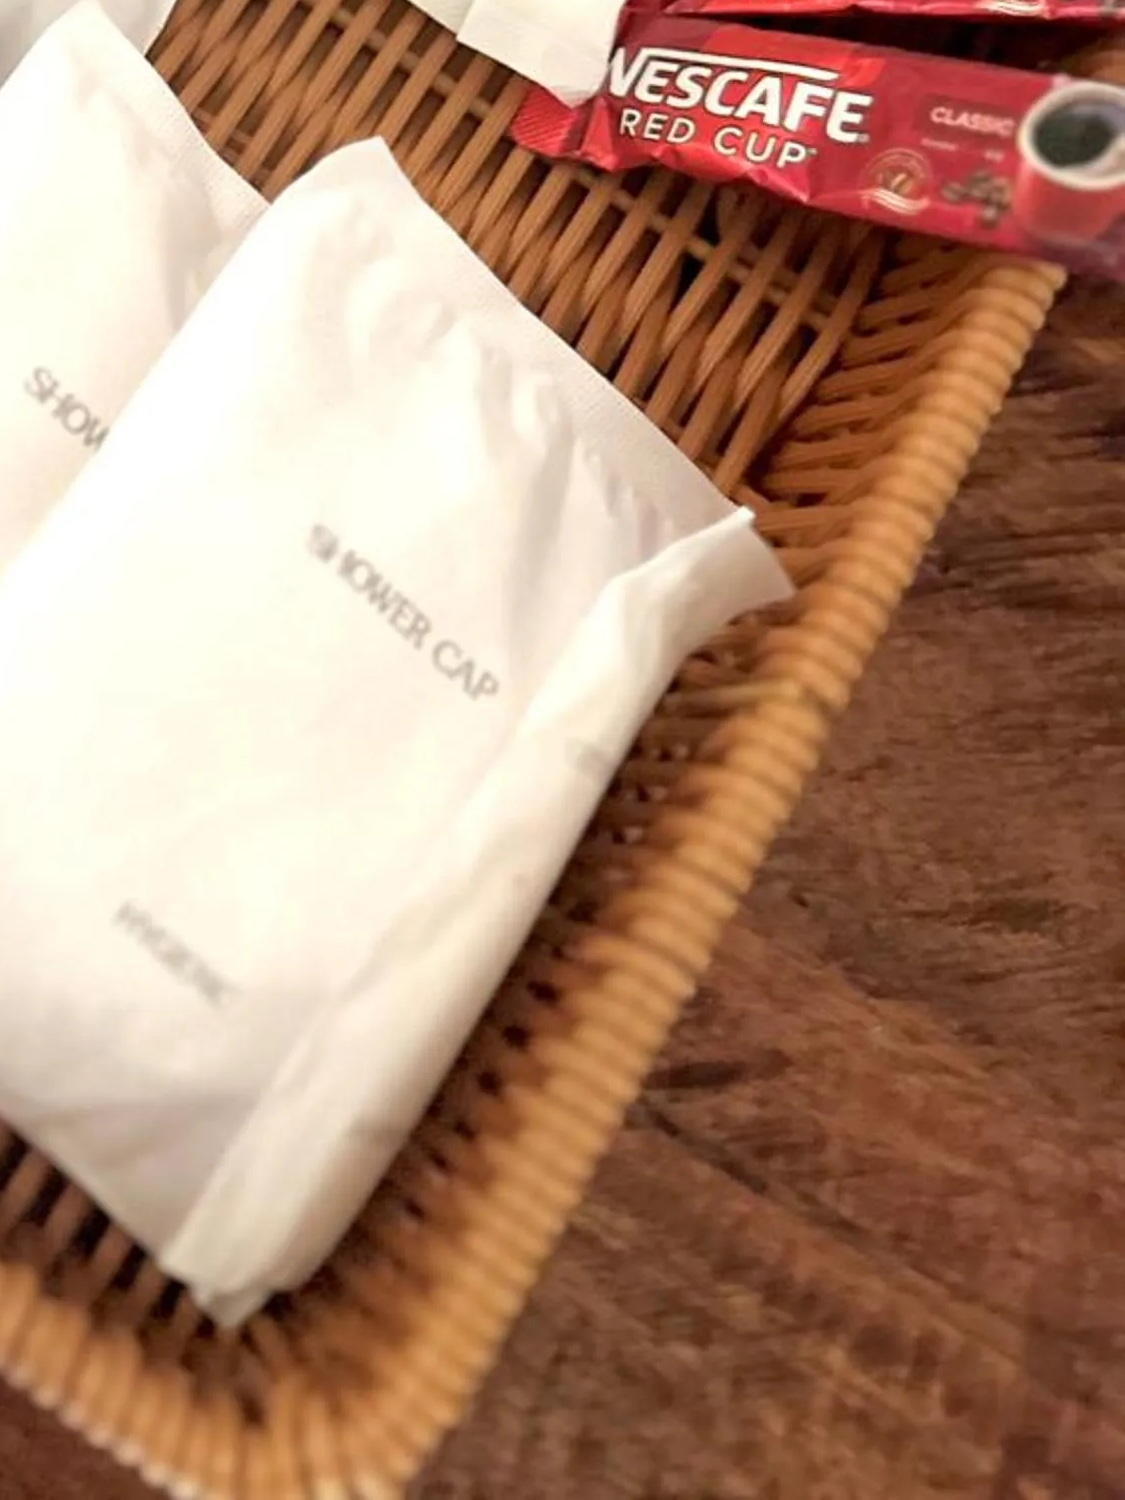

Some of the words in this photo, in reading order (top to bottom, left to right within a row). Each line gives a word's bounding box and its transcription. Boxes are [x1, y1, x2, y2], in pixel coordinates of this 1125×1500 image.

[618, 108, 697, 144] RED
[713, 126, 809, 169] CUP
[431, 638, 501, 702] CAP
